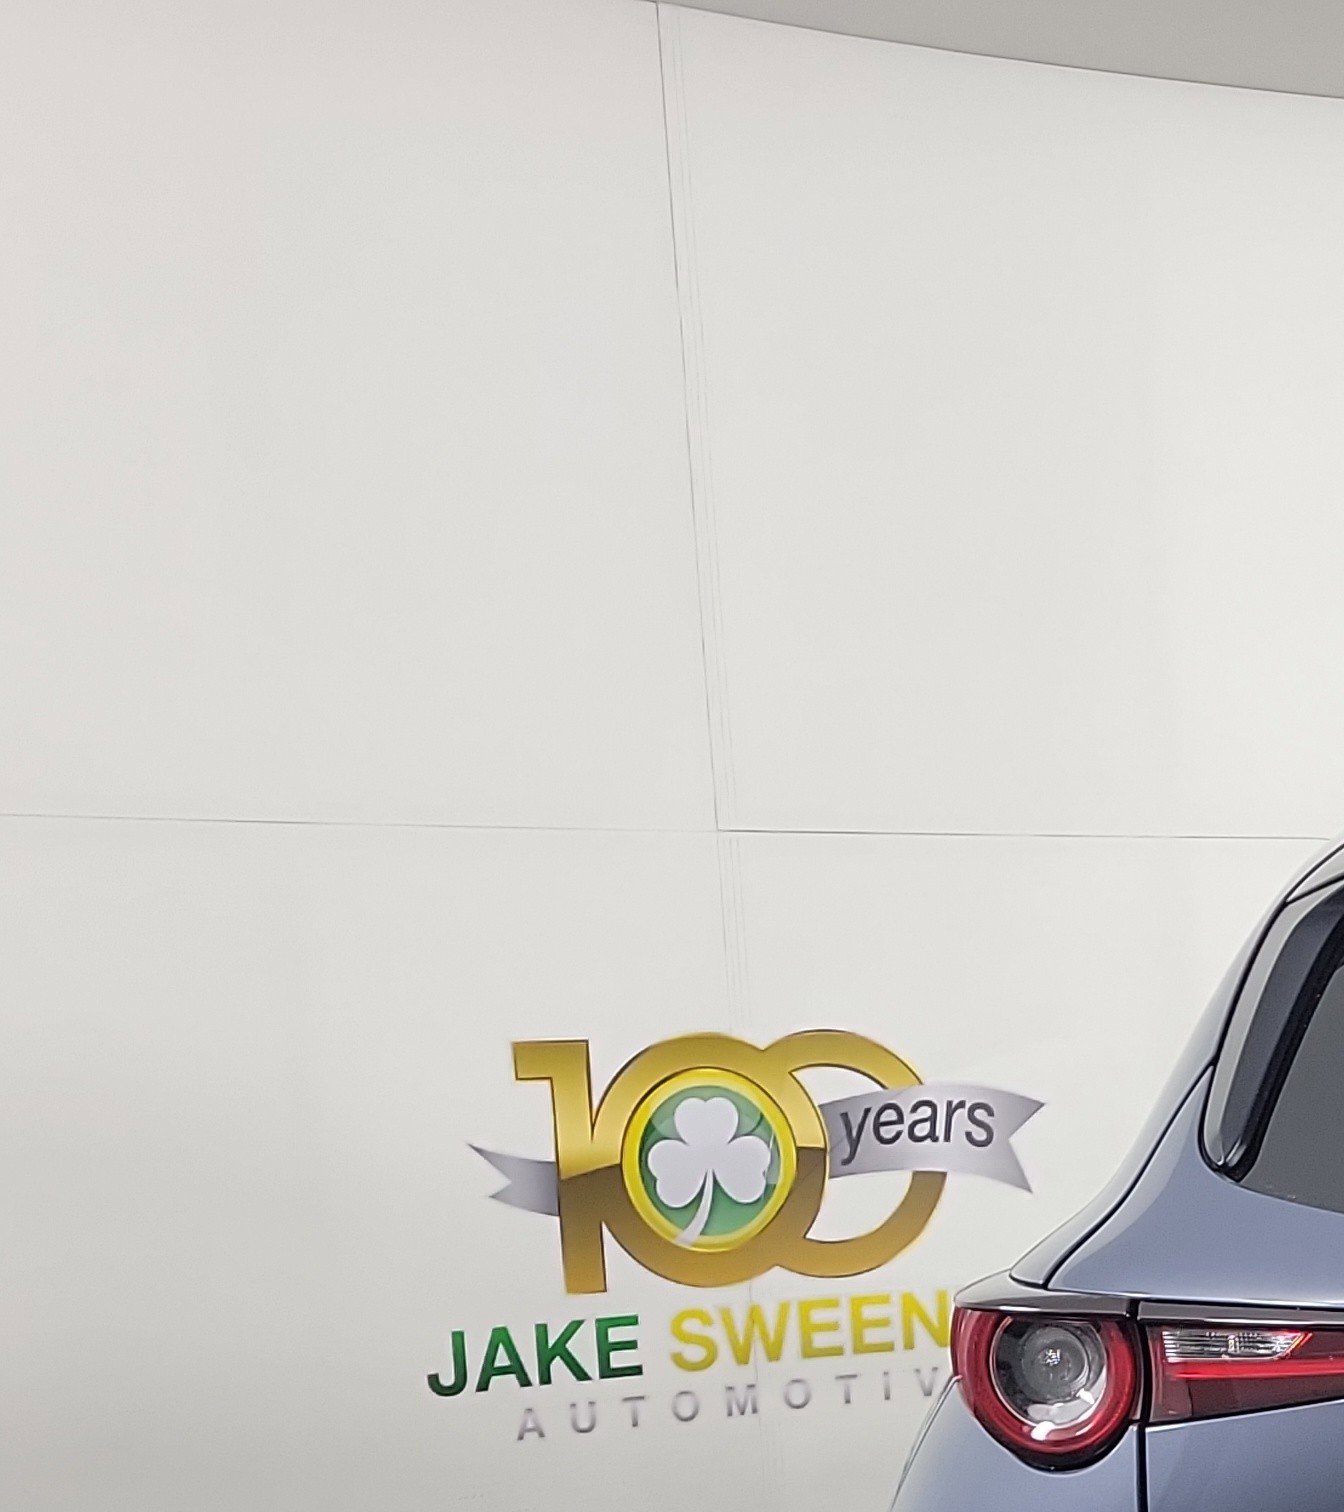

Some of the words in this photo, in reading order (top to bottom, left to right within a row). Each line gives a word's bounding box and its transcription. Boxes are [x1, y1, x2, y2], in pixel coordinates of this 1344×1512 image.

[511, 1029, 946, 1294] 100
[840, 1098, 995, 1165] years
[427, 1314, 643, 1397] JAKE
[670, 1288, 950, 1372] SWEEN
[516, 1366, 939, 1441] AUTOMOTIV
